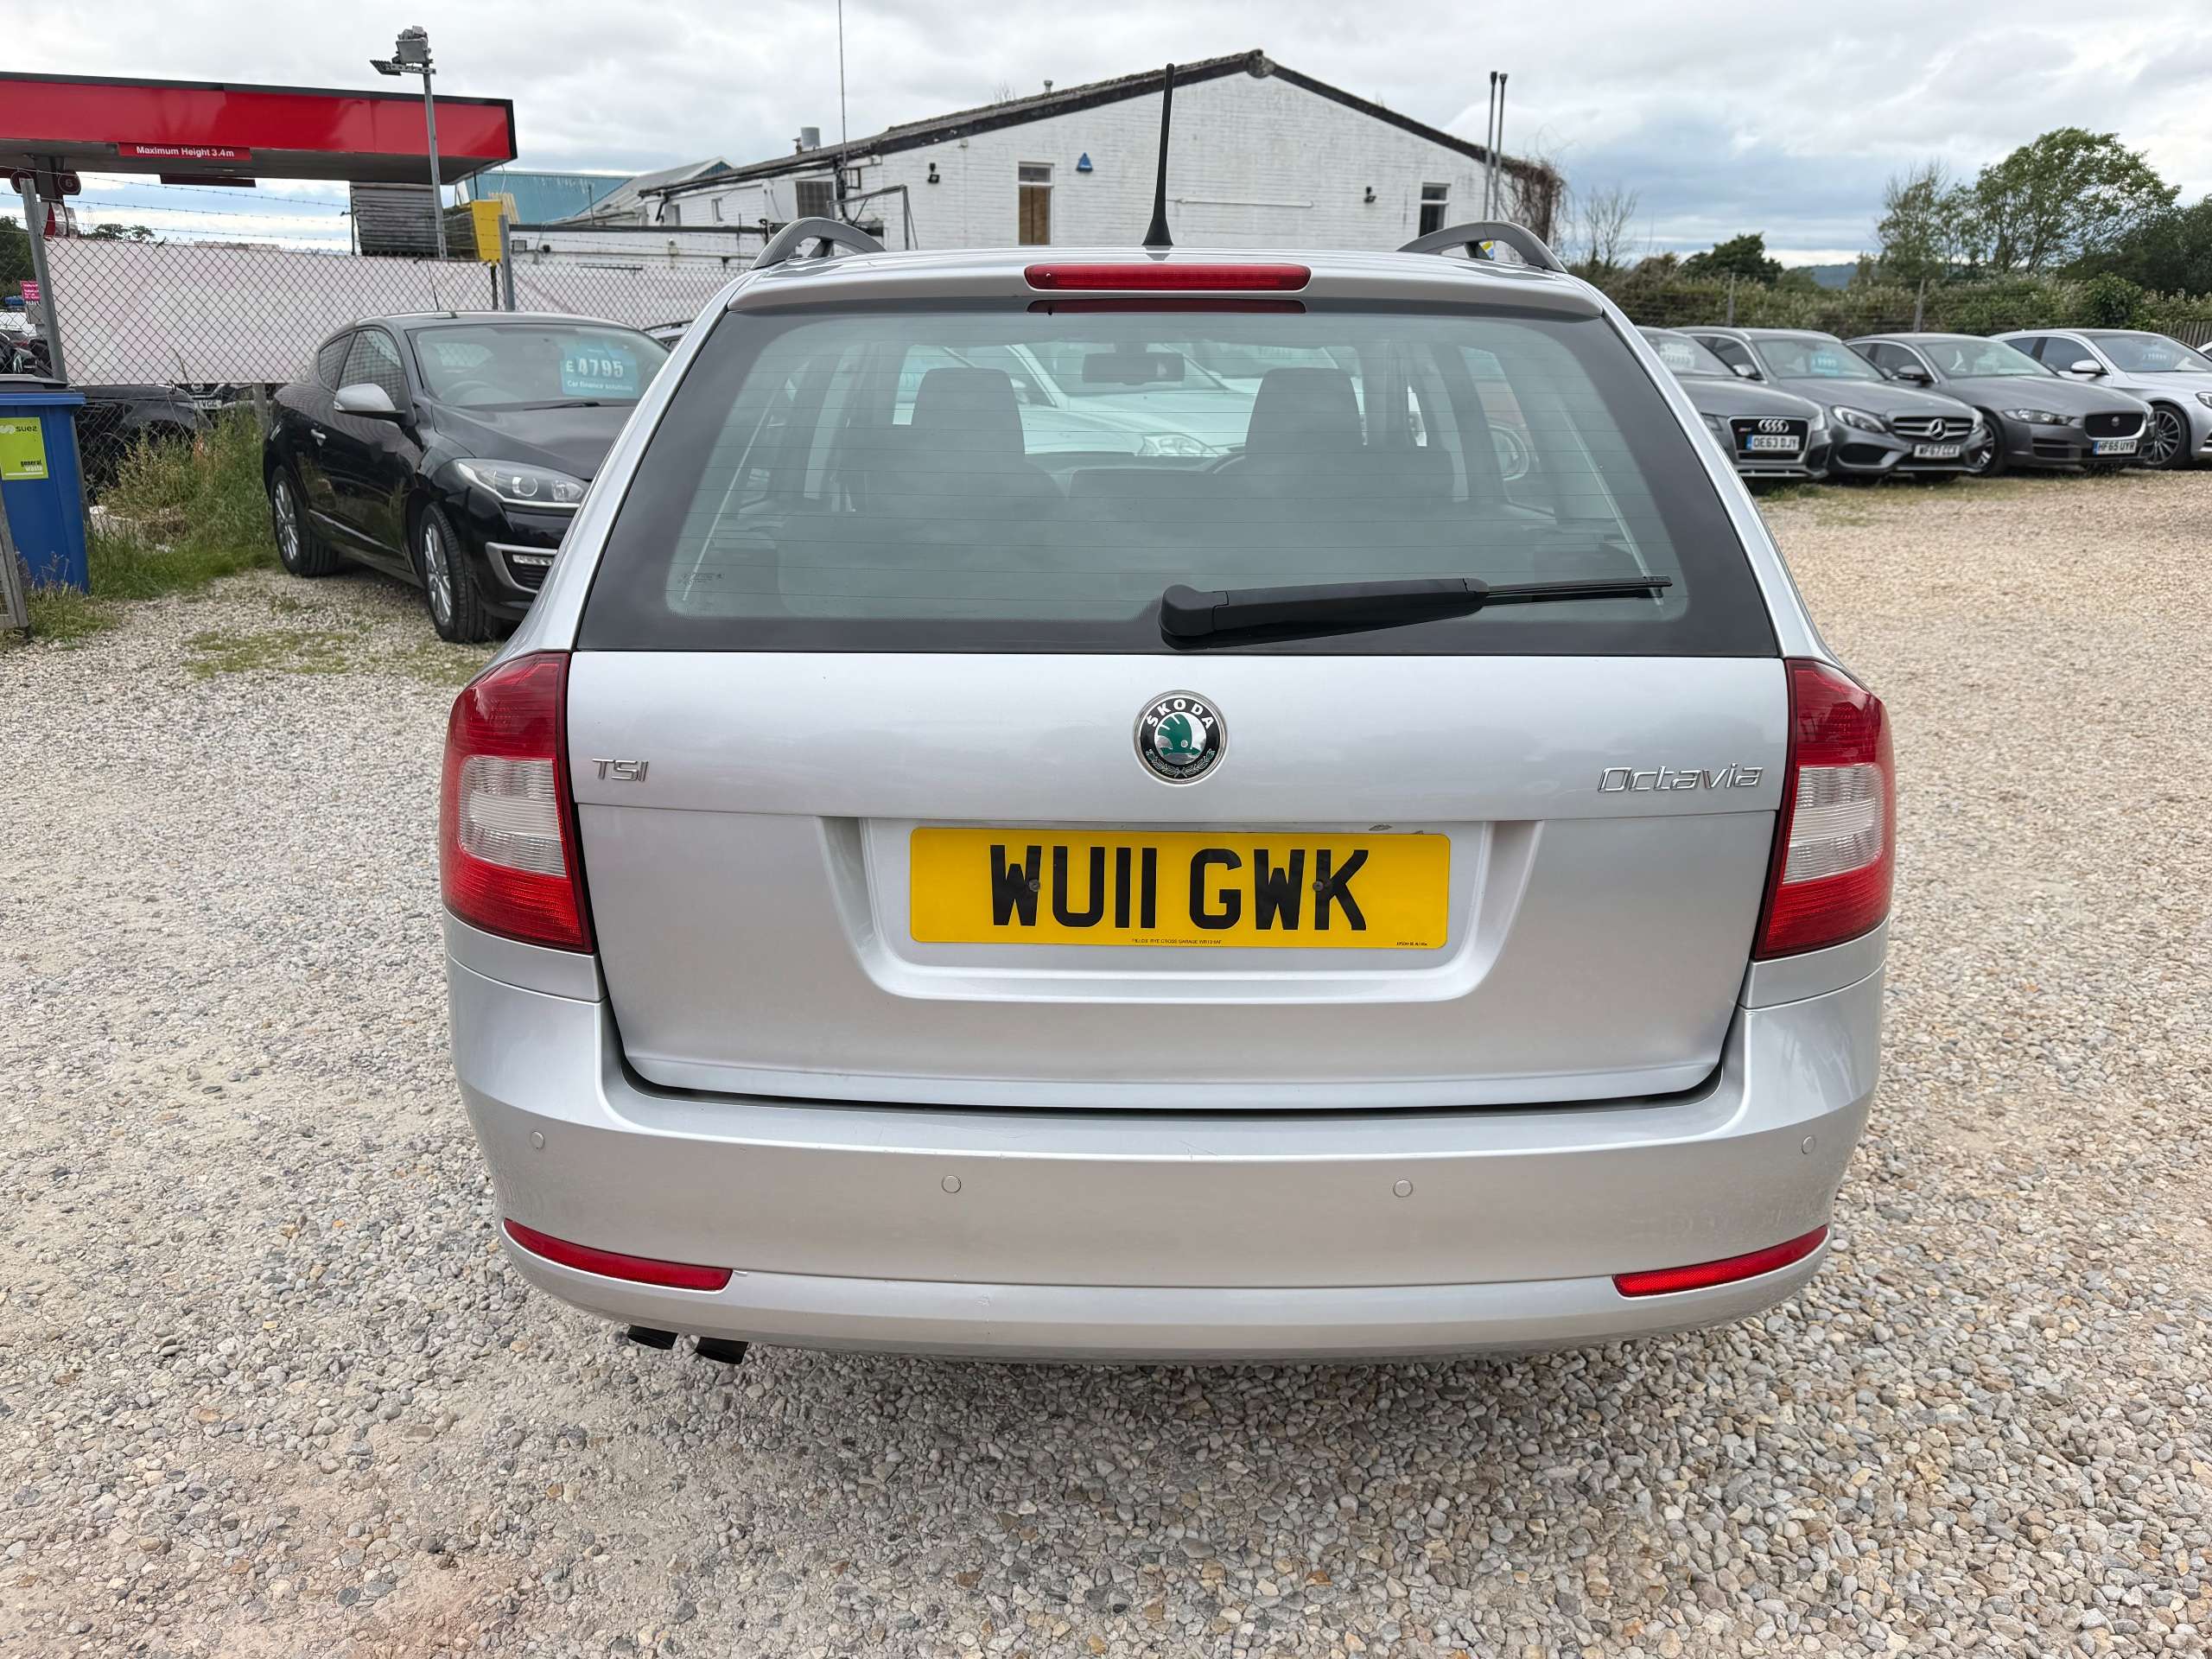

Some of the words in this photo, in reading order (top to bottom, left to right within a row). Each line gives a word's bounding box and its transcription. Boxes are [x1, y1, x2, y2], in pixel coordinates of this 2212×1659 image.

[136, 146, 179, 156] Maximum
[181, 148, 210, 158] Height
[212, 149, 234, 157] 3.4m
[65, 179, 73, 188] 6
[567, 379, 579, 388] Car
[592, 758, 649, 782] TSI
[1598, 762, 1764, 792] Octavia
[990, 844, 1158, 929] WU11
[1190, 848, 1369, 931] GWK
